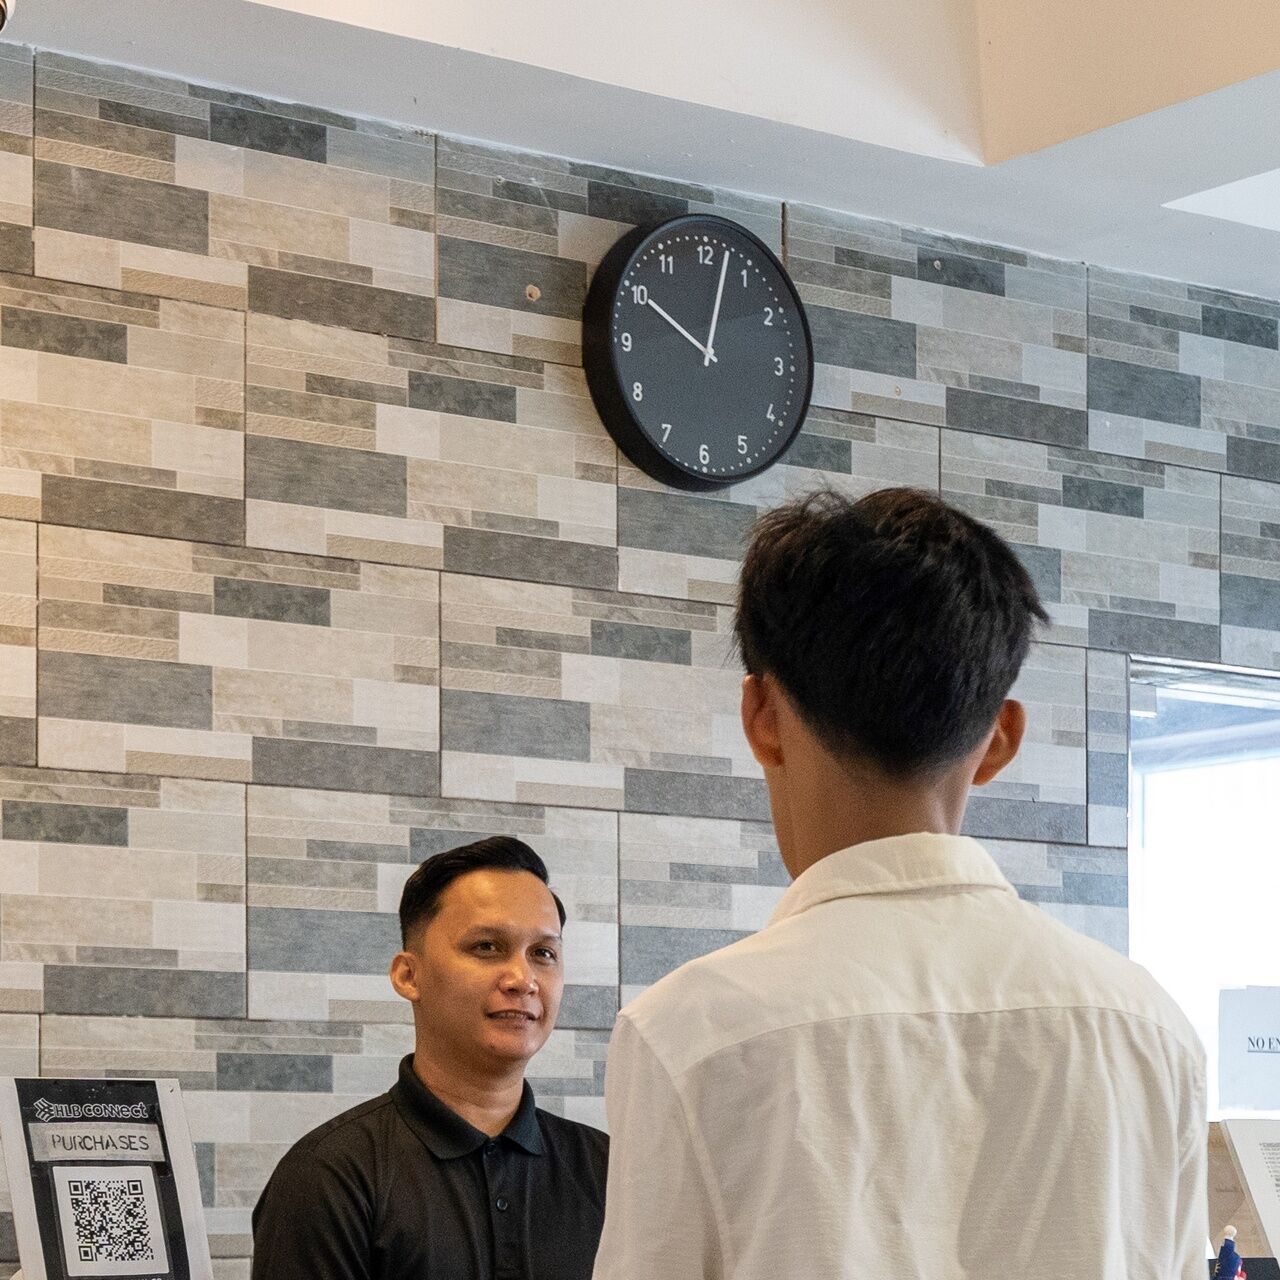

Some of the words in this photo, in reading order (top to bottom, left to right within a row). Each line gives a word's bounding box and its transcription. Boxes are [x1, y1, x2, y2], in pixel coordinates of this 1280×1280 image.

[659, 255, 674, 274] 11
[697, 246, 713, 265] 12
[741, 270, 748, 288] 1
[631, 285, 648, 305] 10
[764, 307, 773, 326] 2
[621, 333, 632, 352] 9
[774, 357, 784, 376] 3
[632, 382, 643, 402] 8
[766, 403, 775, 422] 4
[661, 423, 672, 443] 7
[737, 435, 748, 454] 5
[699, 445, 710, 464] 6
[1247, 1036, 1265, 1049] NO
[53, 1103, 82, 1118] HLB
[52, 1134, 150, 1151] PURCHASES
